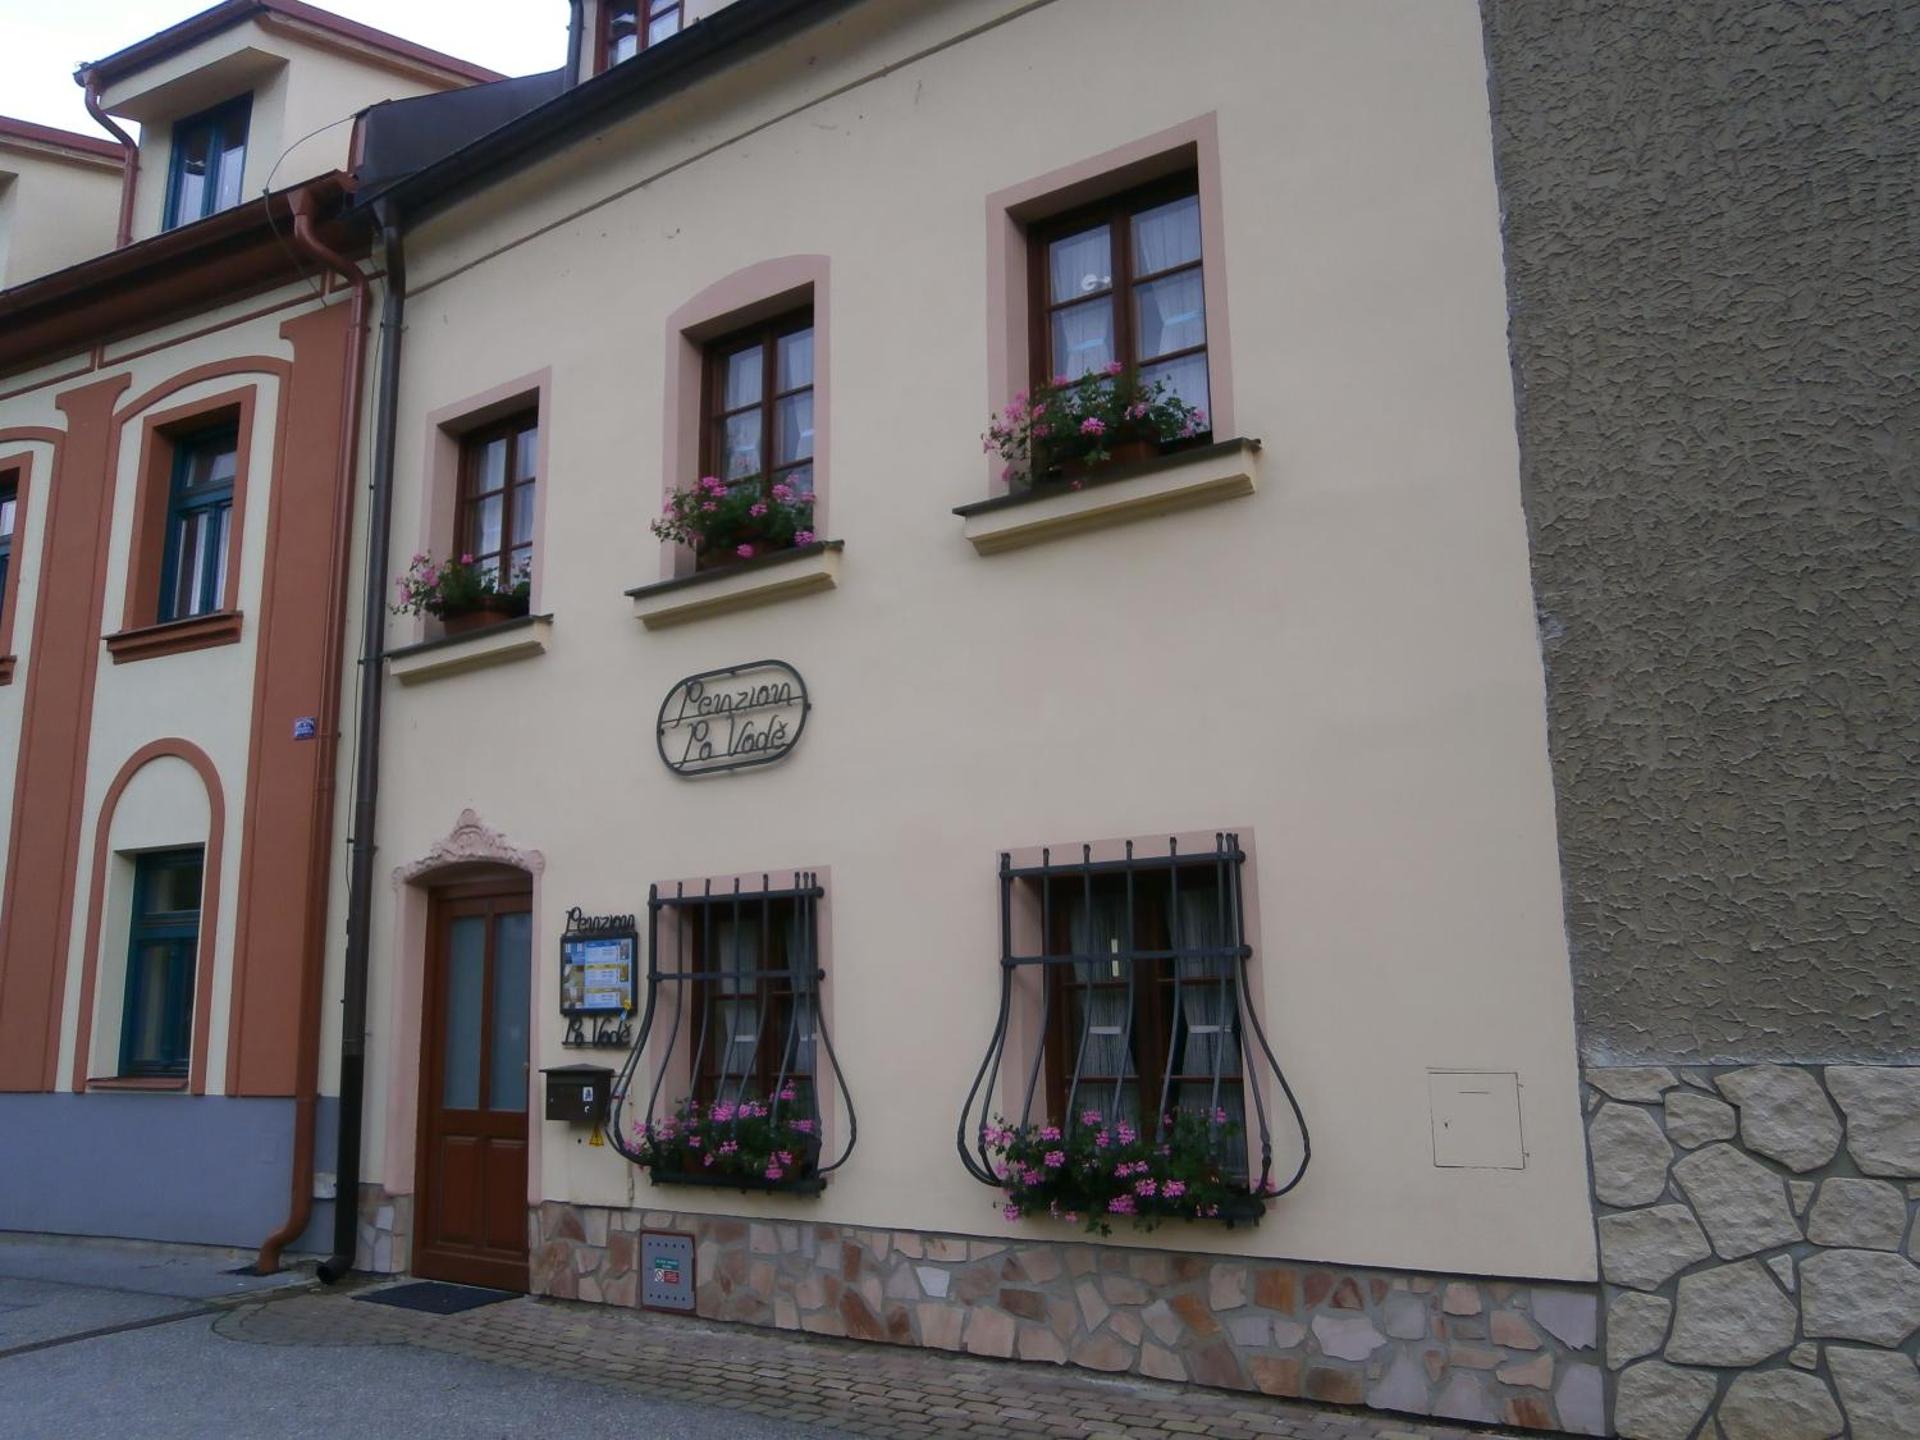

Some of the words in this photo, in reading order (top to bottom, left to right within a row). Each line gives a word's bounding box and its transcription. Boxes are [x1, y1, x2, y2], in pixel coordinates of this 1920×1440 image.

[672, 680, 793, 729] Penzion
[677, 720, 712, 768] Po
[565, 906, 635, 936] Penzion
